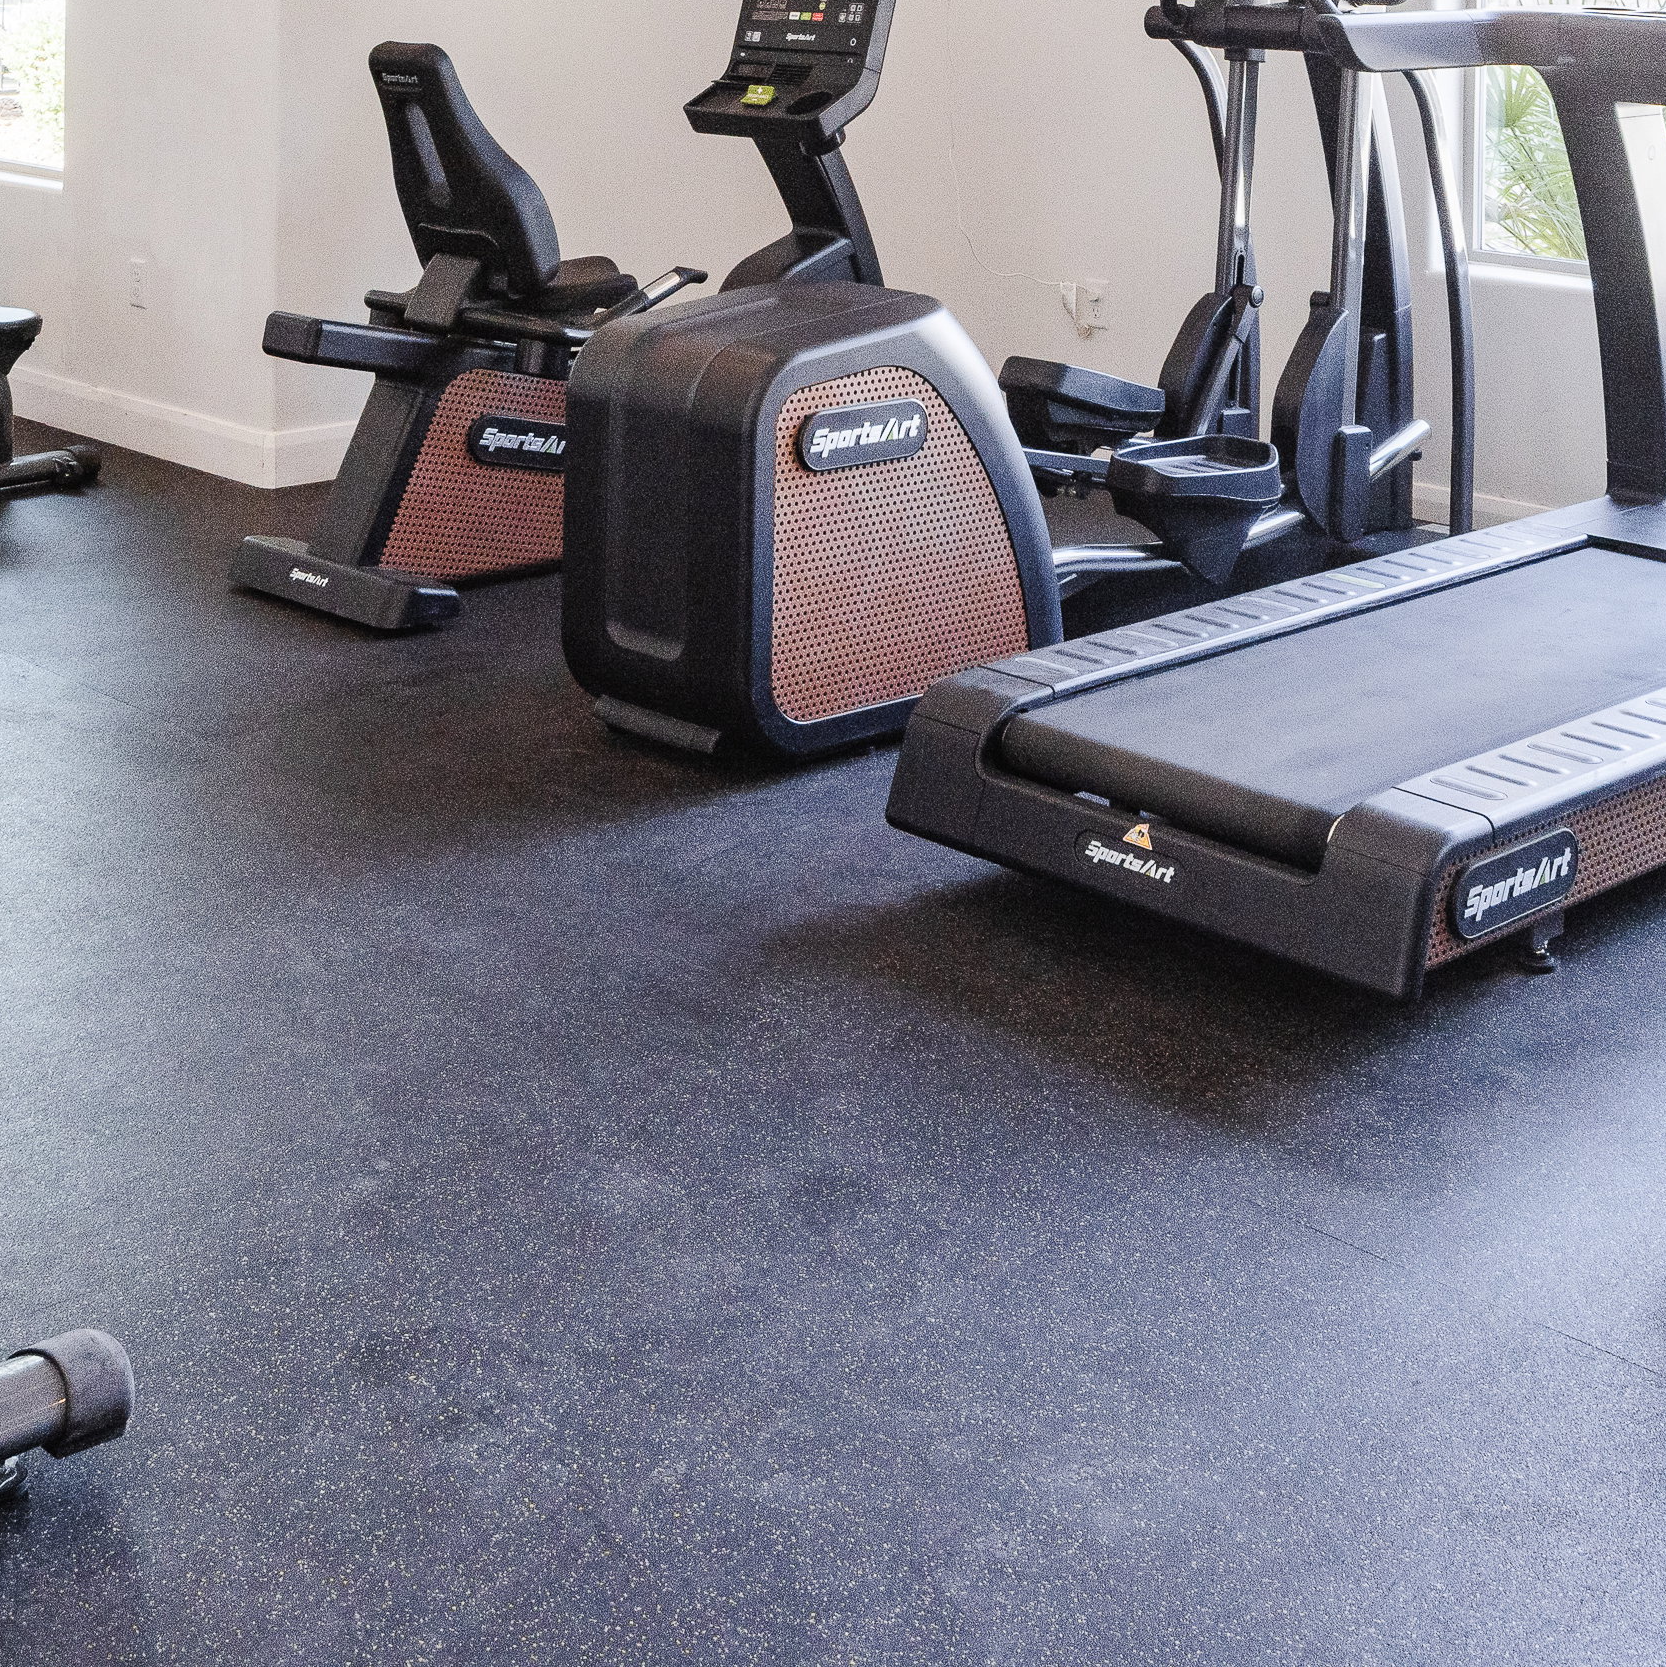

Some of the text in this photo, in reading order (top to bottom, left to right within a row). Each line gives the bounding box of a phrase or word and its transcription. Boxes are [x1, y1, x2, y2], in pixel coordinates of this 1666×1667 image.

[785, 32, 816, 42] SportsArt
[809, 414, 921, 459] SportsArt
[289, 567, 329, 587] SportsArt
[1084, 840, 1175, 884] SportsArt
[1464, 847, 1572, 922] SportsArt
